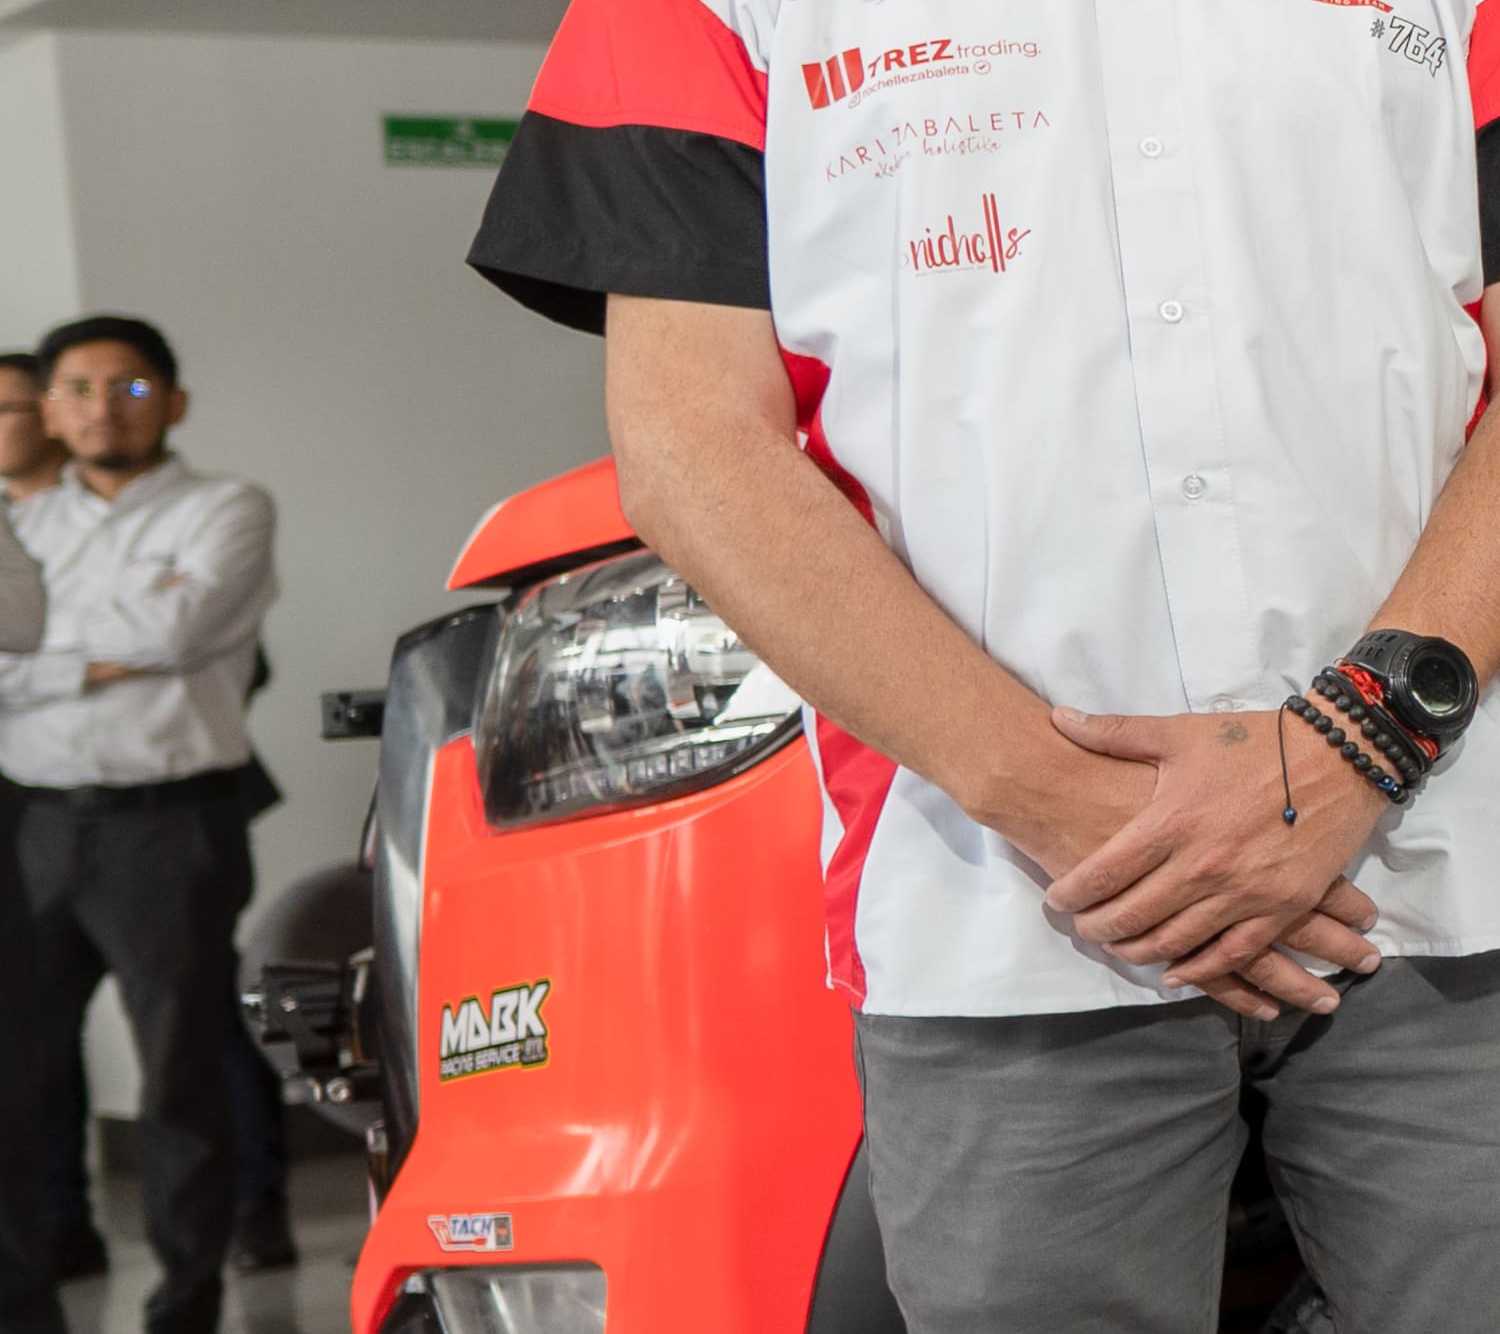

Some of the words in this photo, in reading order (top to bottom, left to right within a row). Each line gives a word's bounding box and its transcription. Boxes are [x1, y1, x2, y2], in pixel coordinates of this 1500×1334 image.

[867, 39, 954, 77] TREZ
[862, 65, 969, 98] rochellezabaleta
[825, 138, 887, 182] KARI
[892, 110, 1050, 146] ZABALETA
